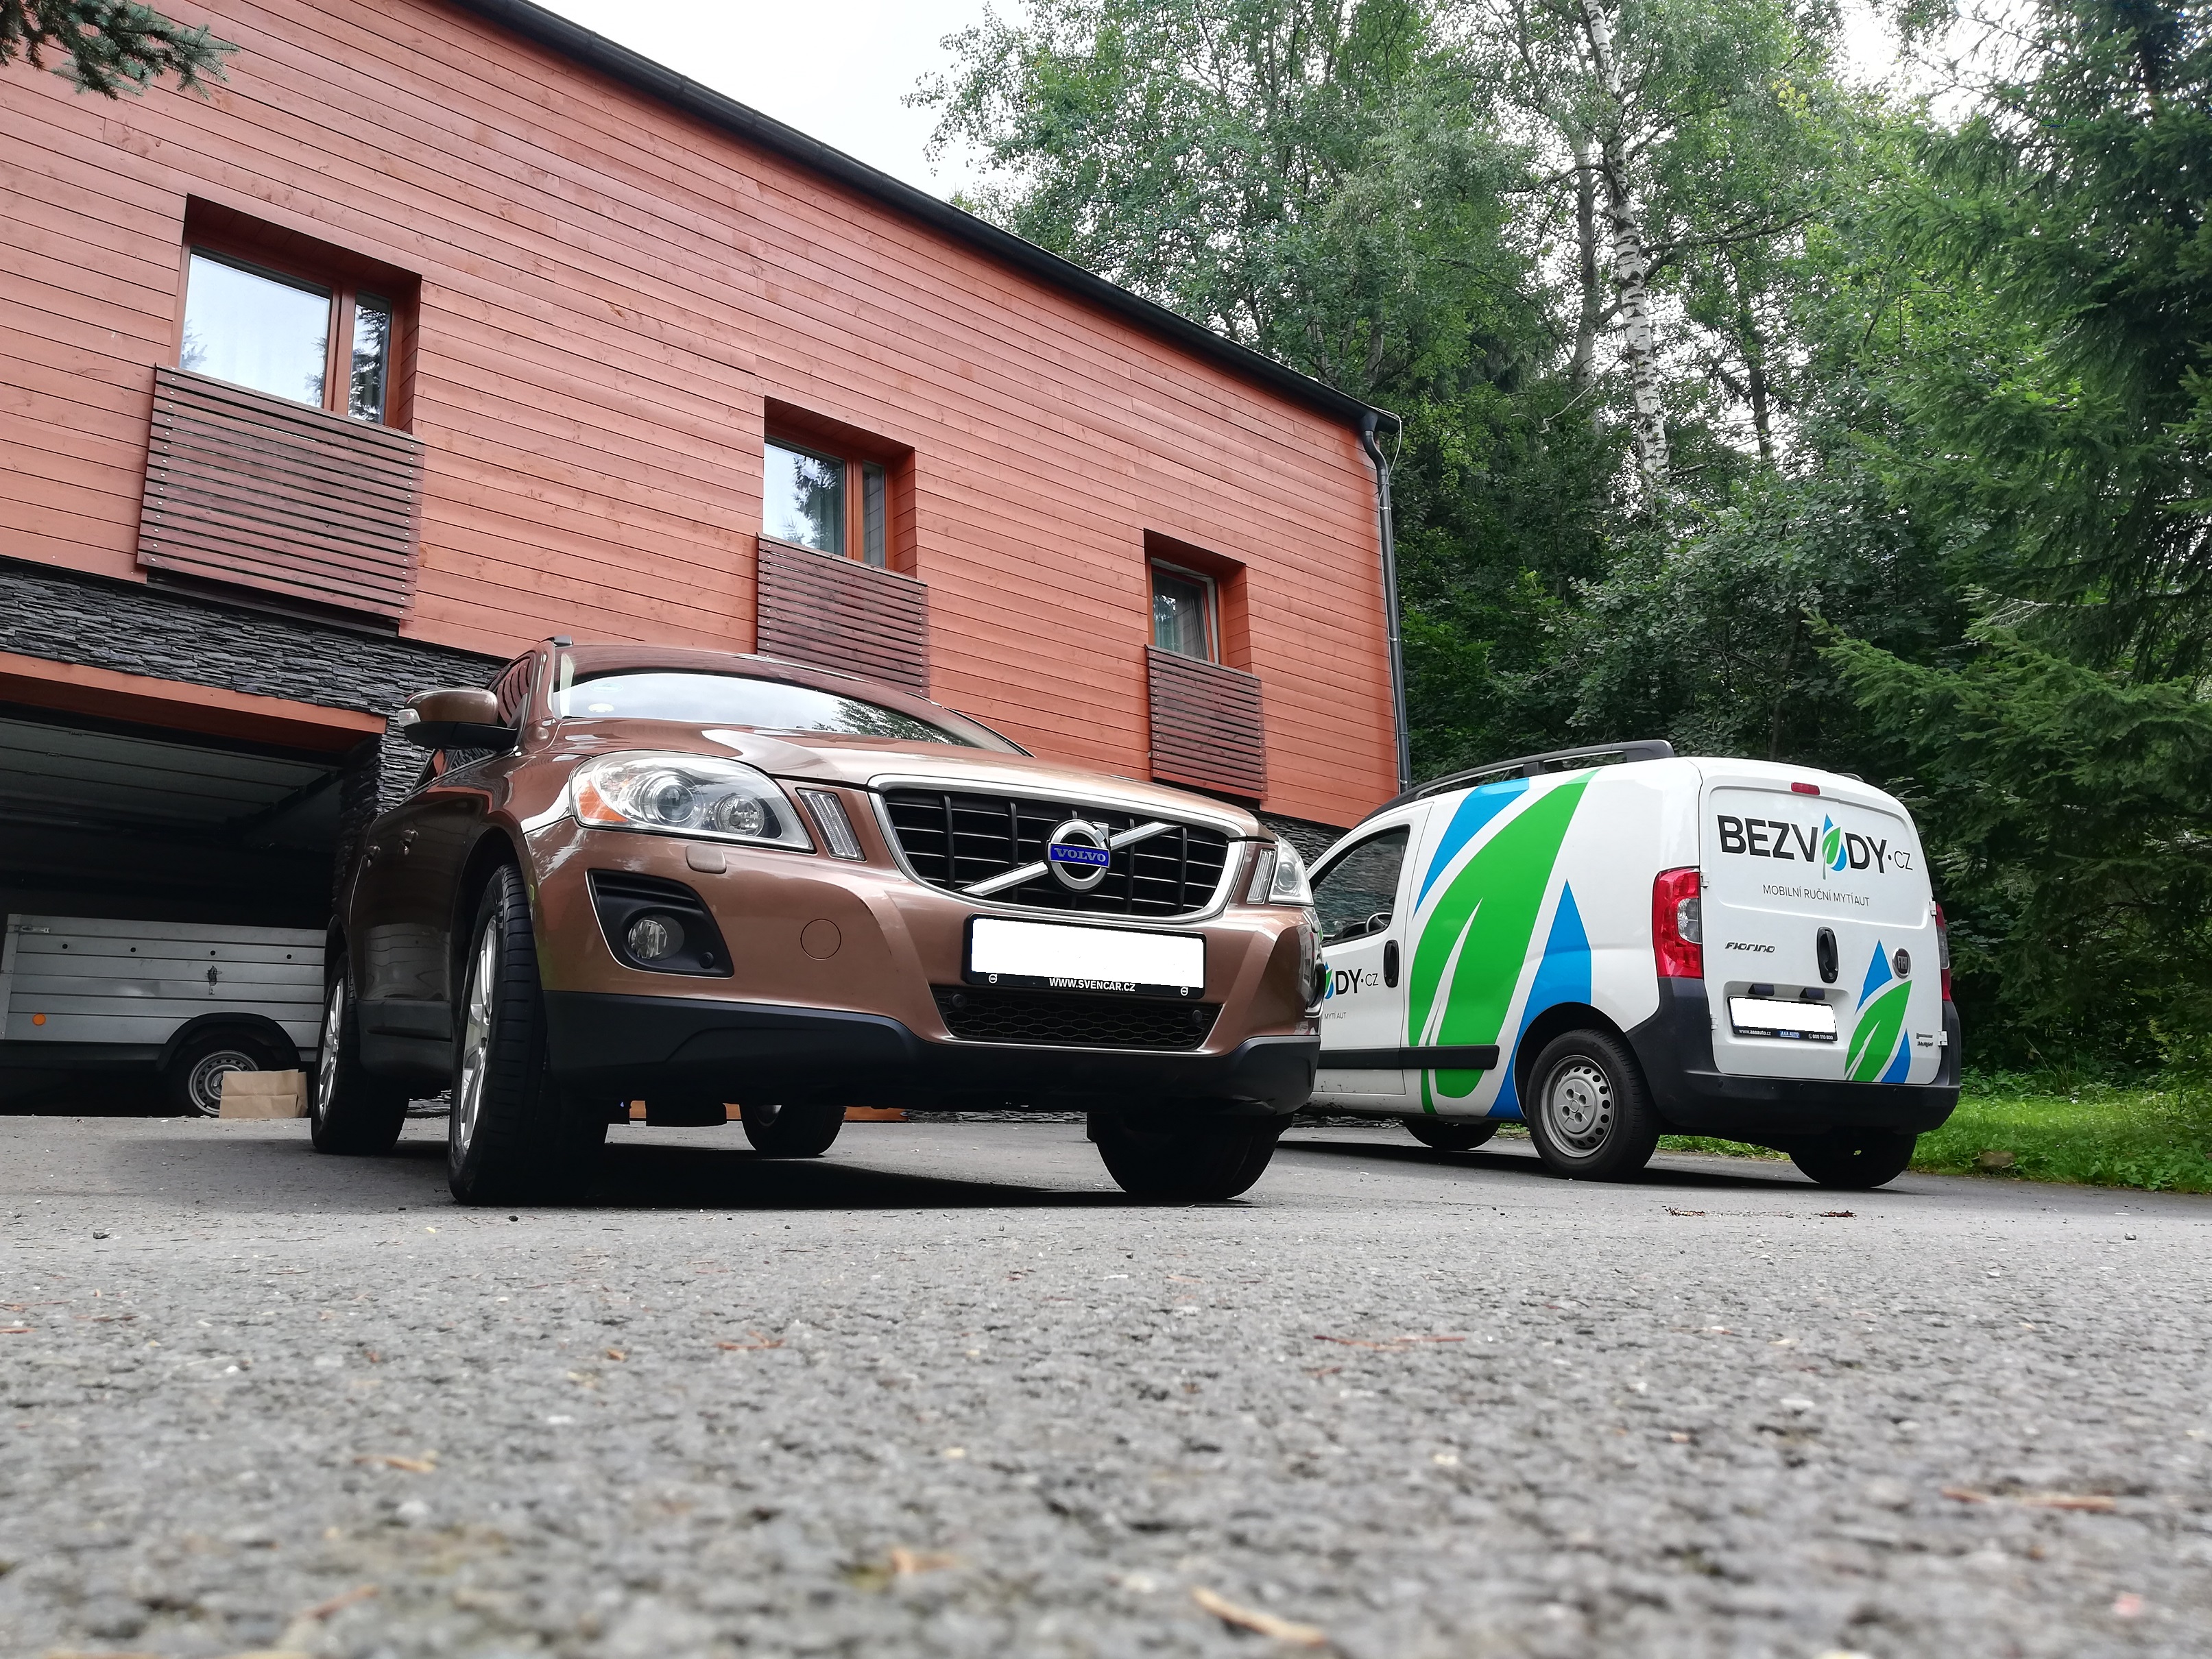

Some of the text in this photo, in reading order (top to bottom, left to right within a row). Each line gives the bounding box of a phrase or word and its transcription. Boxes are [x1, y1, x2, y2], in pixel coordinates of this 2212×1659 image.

[1053, 847, 1106, 862] VOLVO
[1763, 884, 1802, 898] MOBILNÍ
[1804, 888, 1831, 901] RUČNÍ
[1897, 955, 1908, 970] FIAT
[1048, 977, 1136, 992] WWW.SVENCAR.CZ
